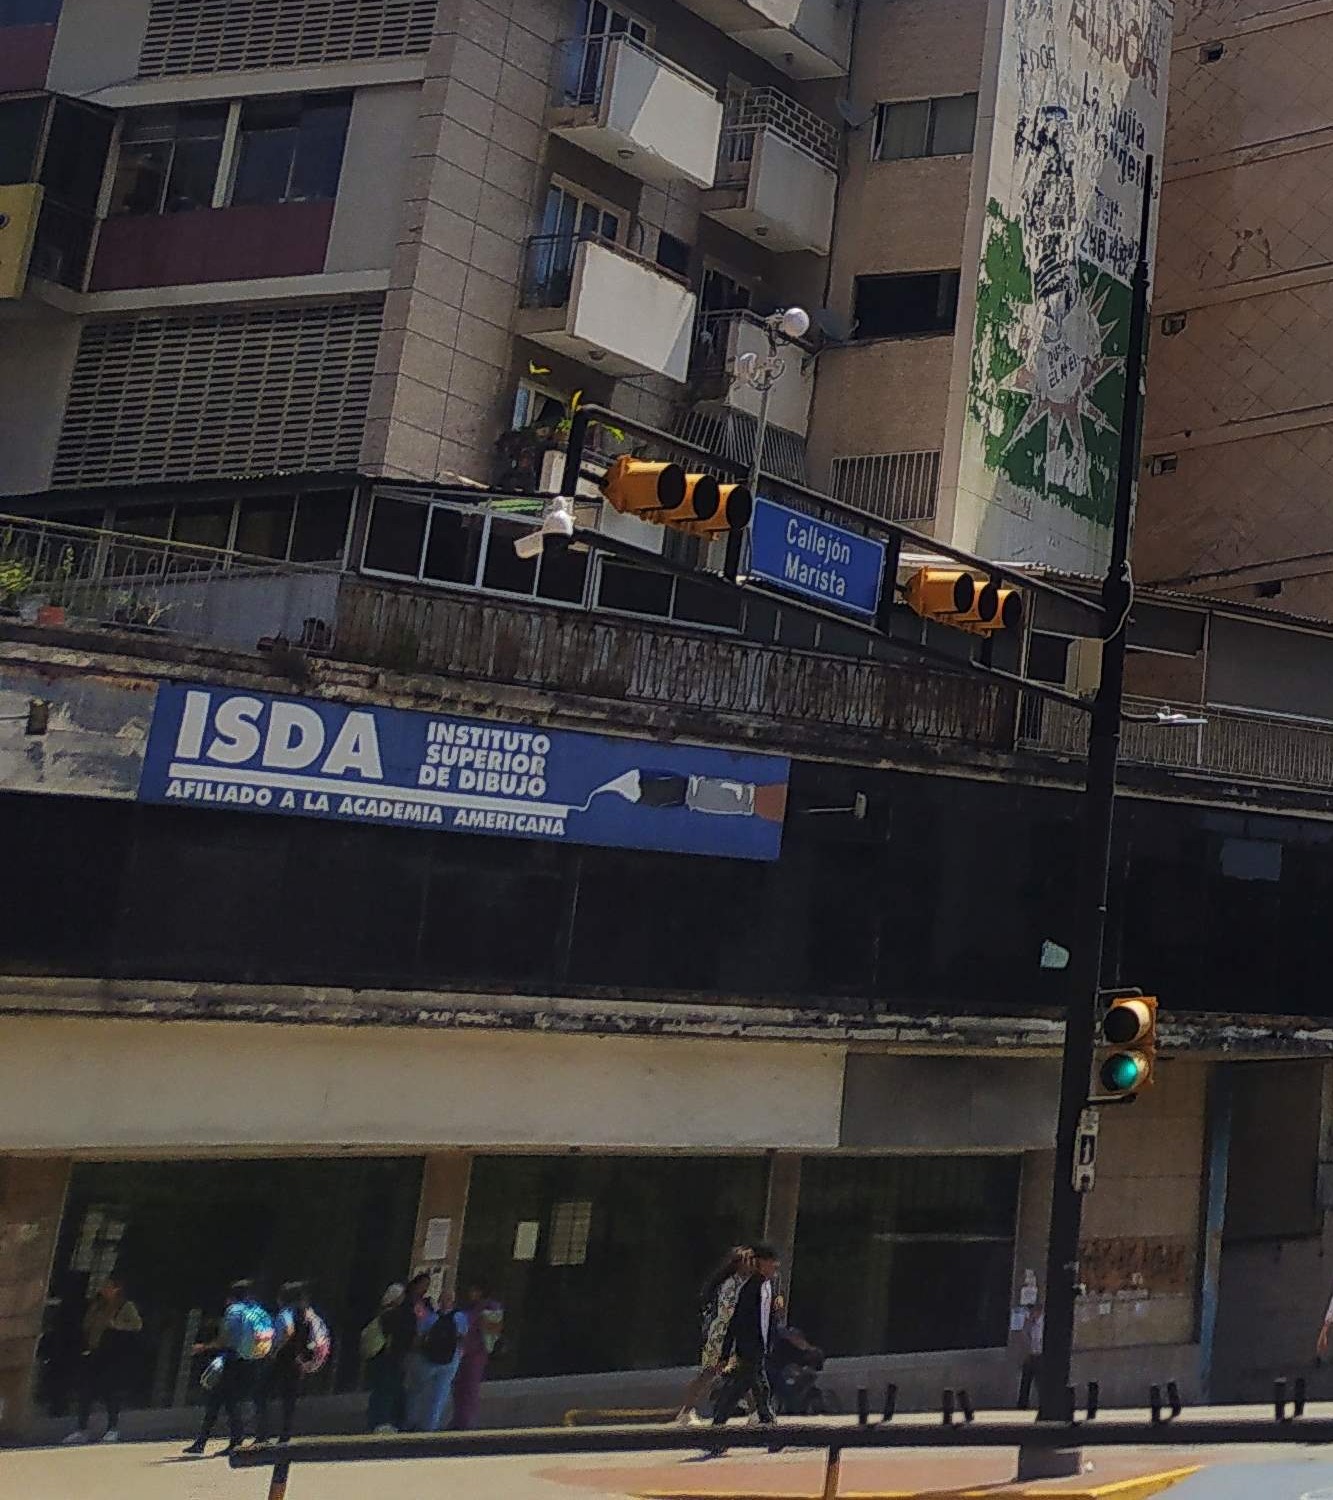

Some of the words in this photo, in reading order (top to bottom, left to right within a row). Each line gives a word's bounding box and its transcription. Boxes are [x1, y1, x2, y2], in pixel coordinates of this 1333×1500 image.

[786, 518, 851, 565] Callejón
[784, 551, 846, 597] Marista
[174, 690, 384, 780] ISDA
[427, 721, 551, 755] INSTITUTO
[418, 764, 451, 788] DE
[458, 768, 546, 798] DIBUJO
[425, 743, 546, 776] SUPERIOR
[165, 779, 272, 807] AFILIADO
[279, 790, 295, 810] A
[303, 792, 330, 812] LA
[337, 796, 443, 825] ACADEMIA
[453, 807, 566, 837] AMERICANA
